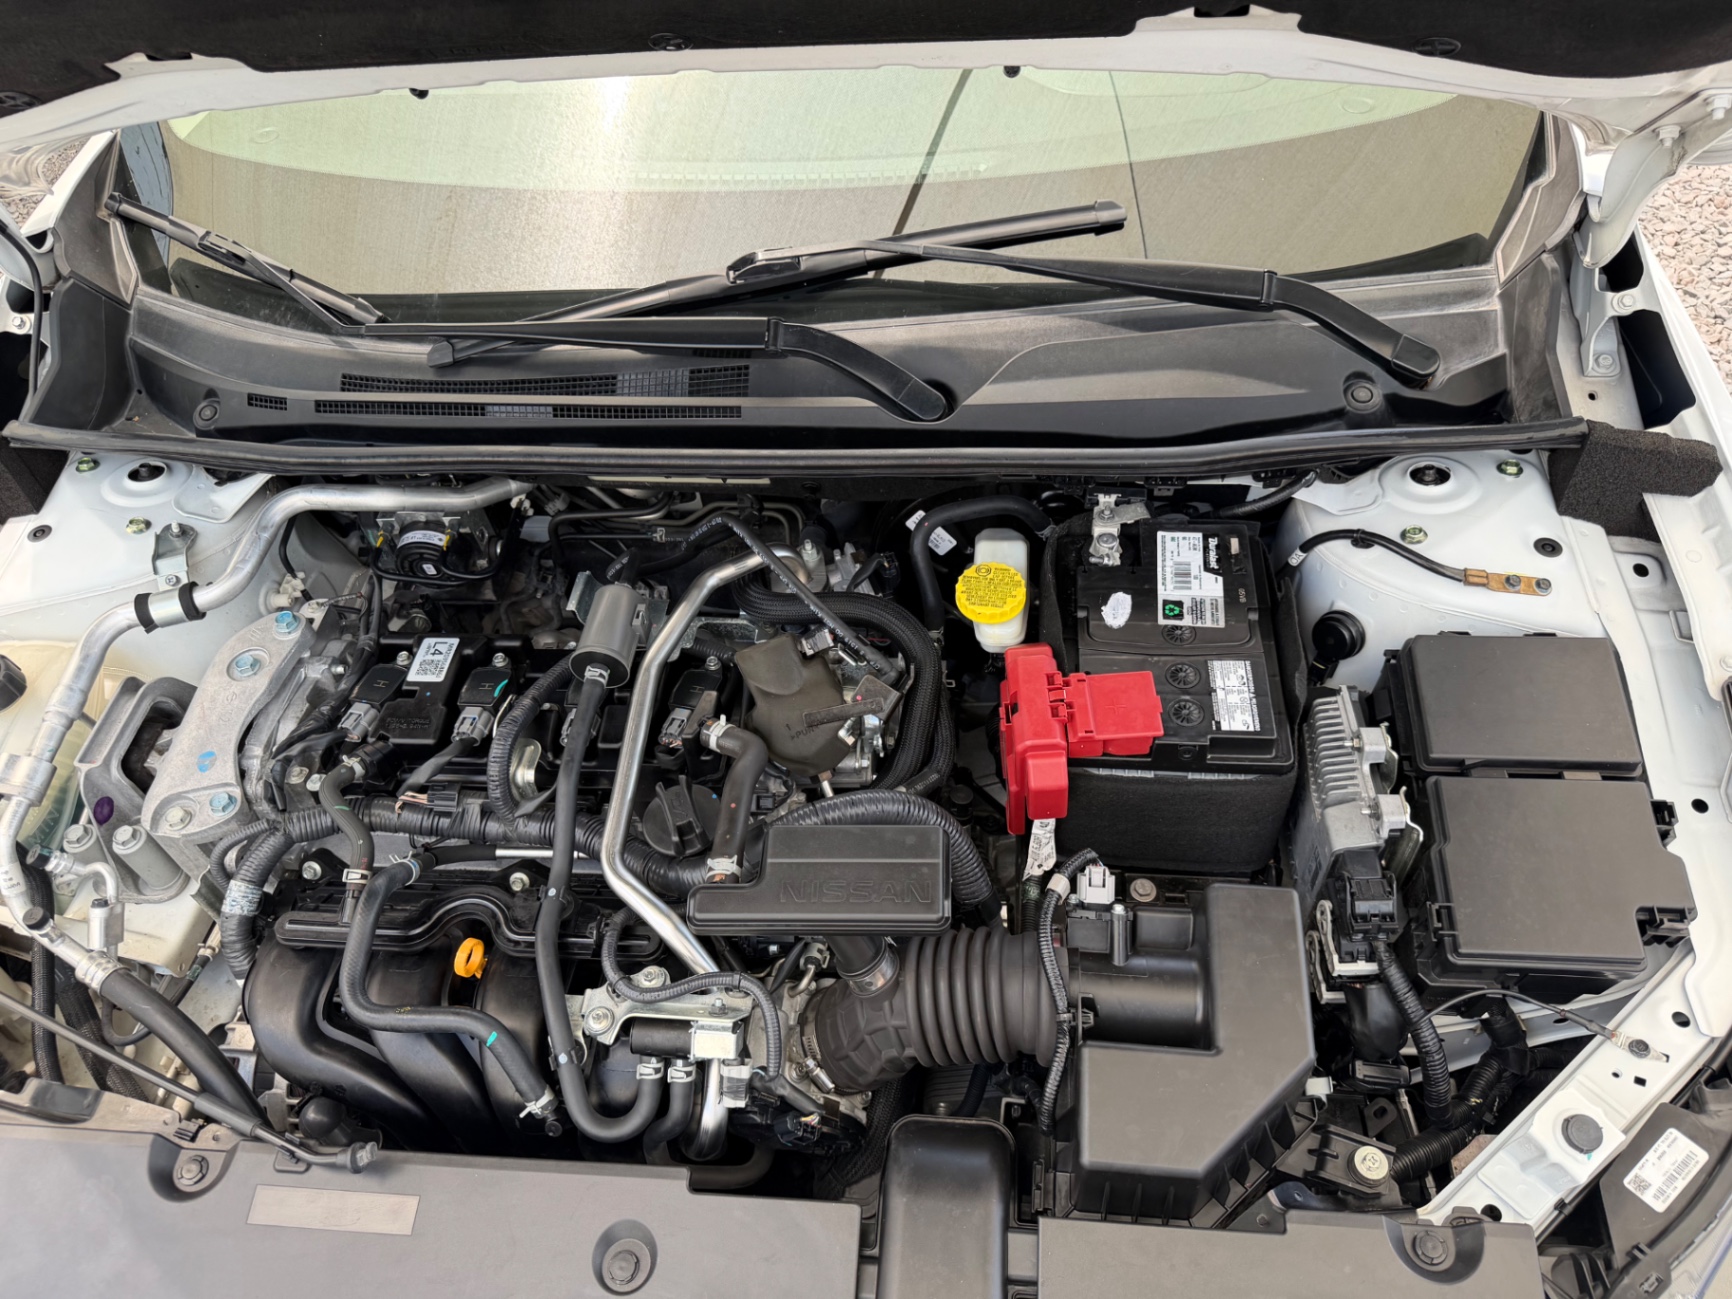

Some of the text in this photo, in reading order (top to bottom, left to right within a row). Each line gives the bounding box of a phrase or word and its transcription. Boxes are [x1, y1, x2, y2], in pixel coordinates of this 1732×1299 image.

[1208, 536, 1219, 569] Duralast
[429, 641, 449, 657] L4
[779, 880, 932, 903] NISSAN
